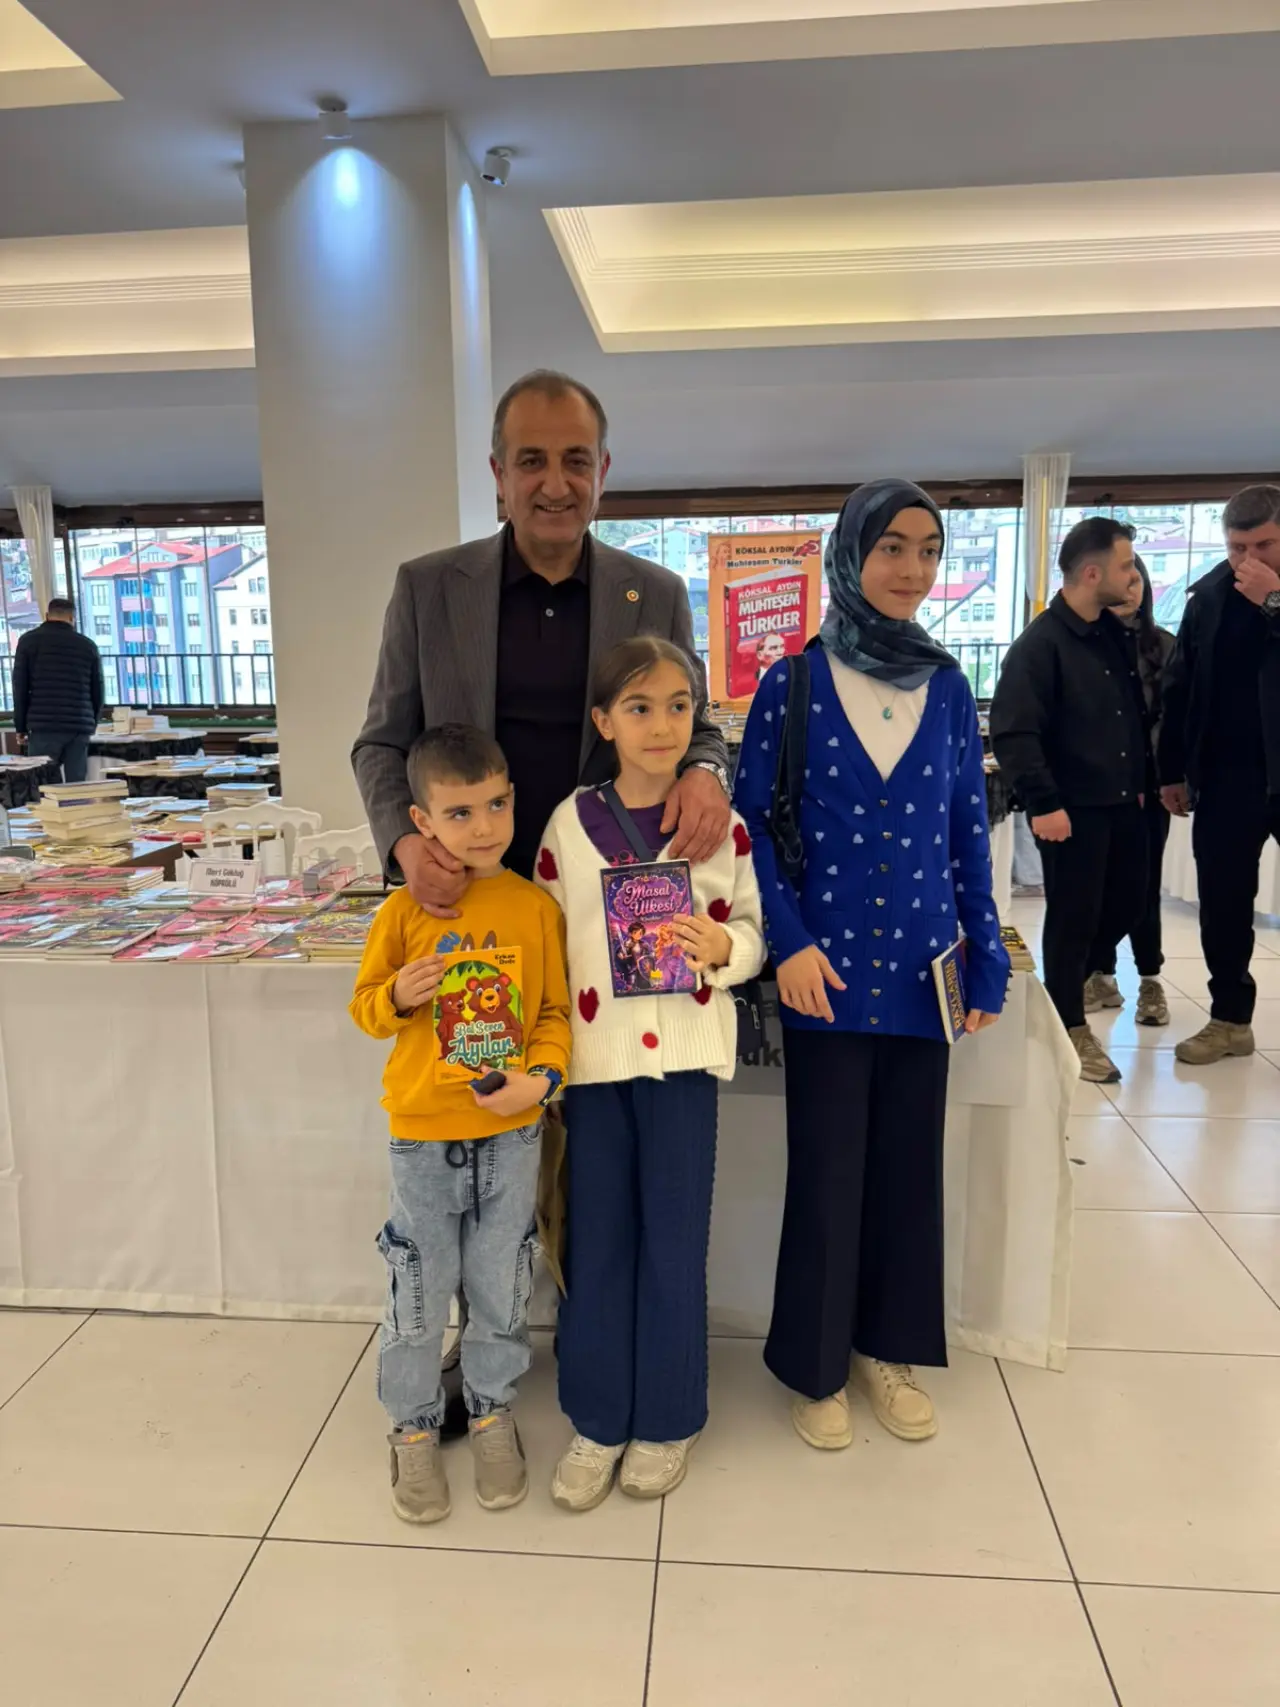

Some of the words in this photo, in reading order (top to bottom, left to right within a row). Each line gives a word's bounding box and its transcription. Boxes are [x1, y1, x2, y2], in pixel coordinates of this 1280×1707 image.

[769, 545, 795, 553] AYDIN
[776, 580, 802, 593] AYDIN
[738, 592, 800, 617] MUHTEŞEM
[738, 611, 800, 638] TÜRKLER
[624, 884, 671, 905] Masal
[475, 1020, 506, 1036] Seven
[497, 1059, 504, 1069] 2
